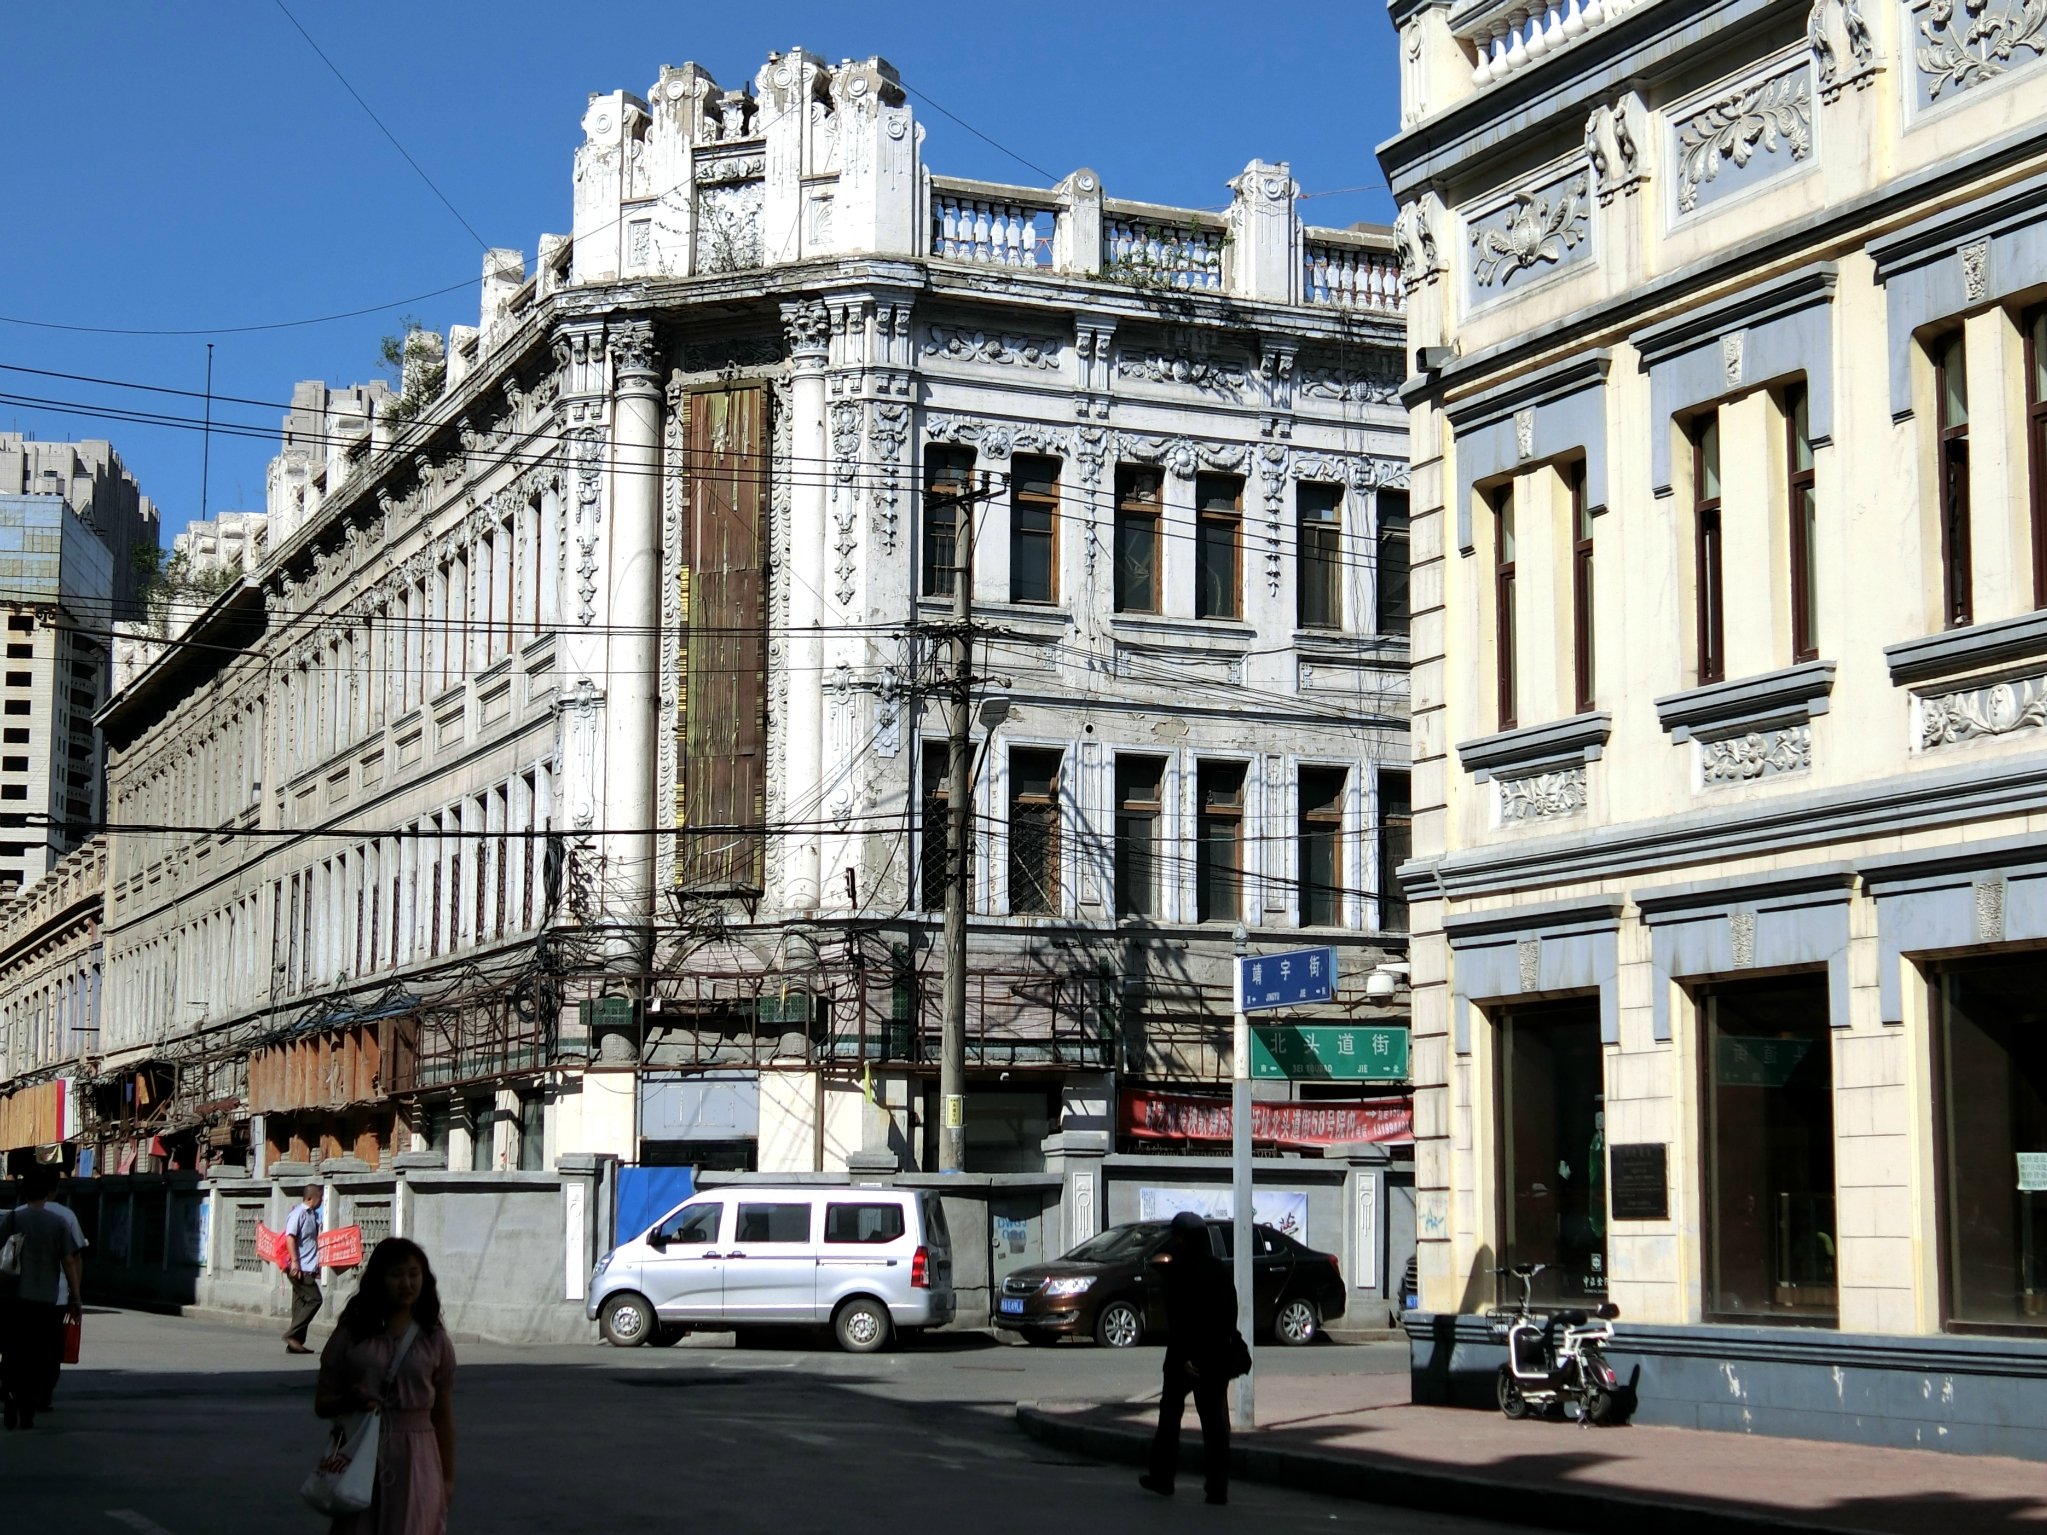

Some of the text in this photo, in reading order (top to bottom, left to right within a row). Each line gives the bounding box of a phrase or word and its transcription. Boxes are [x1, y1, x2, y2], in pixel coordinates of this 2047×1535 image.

[1252, 955, 1320, 986] 靖宇街
[1270, 1032, 1390, 1056] 北头道街
[1357, 1064, 1368, 1073] JIE
